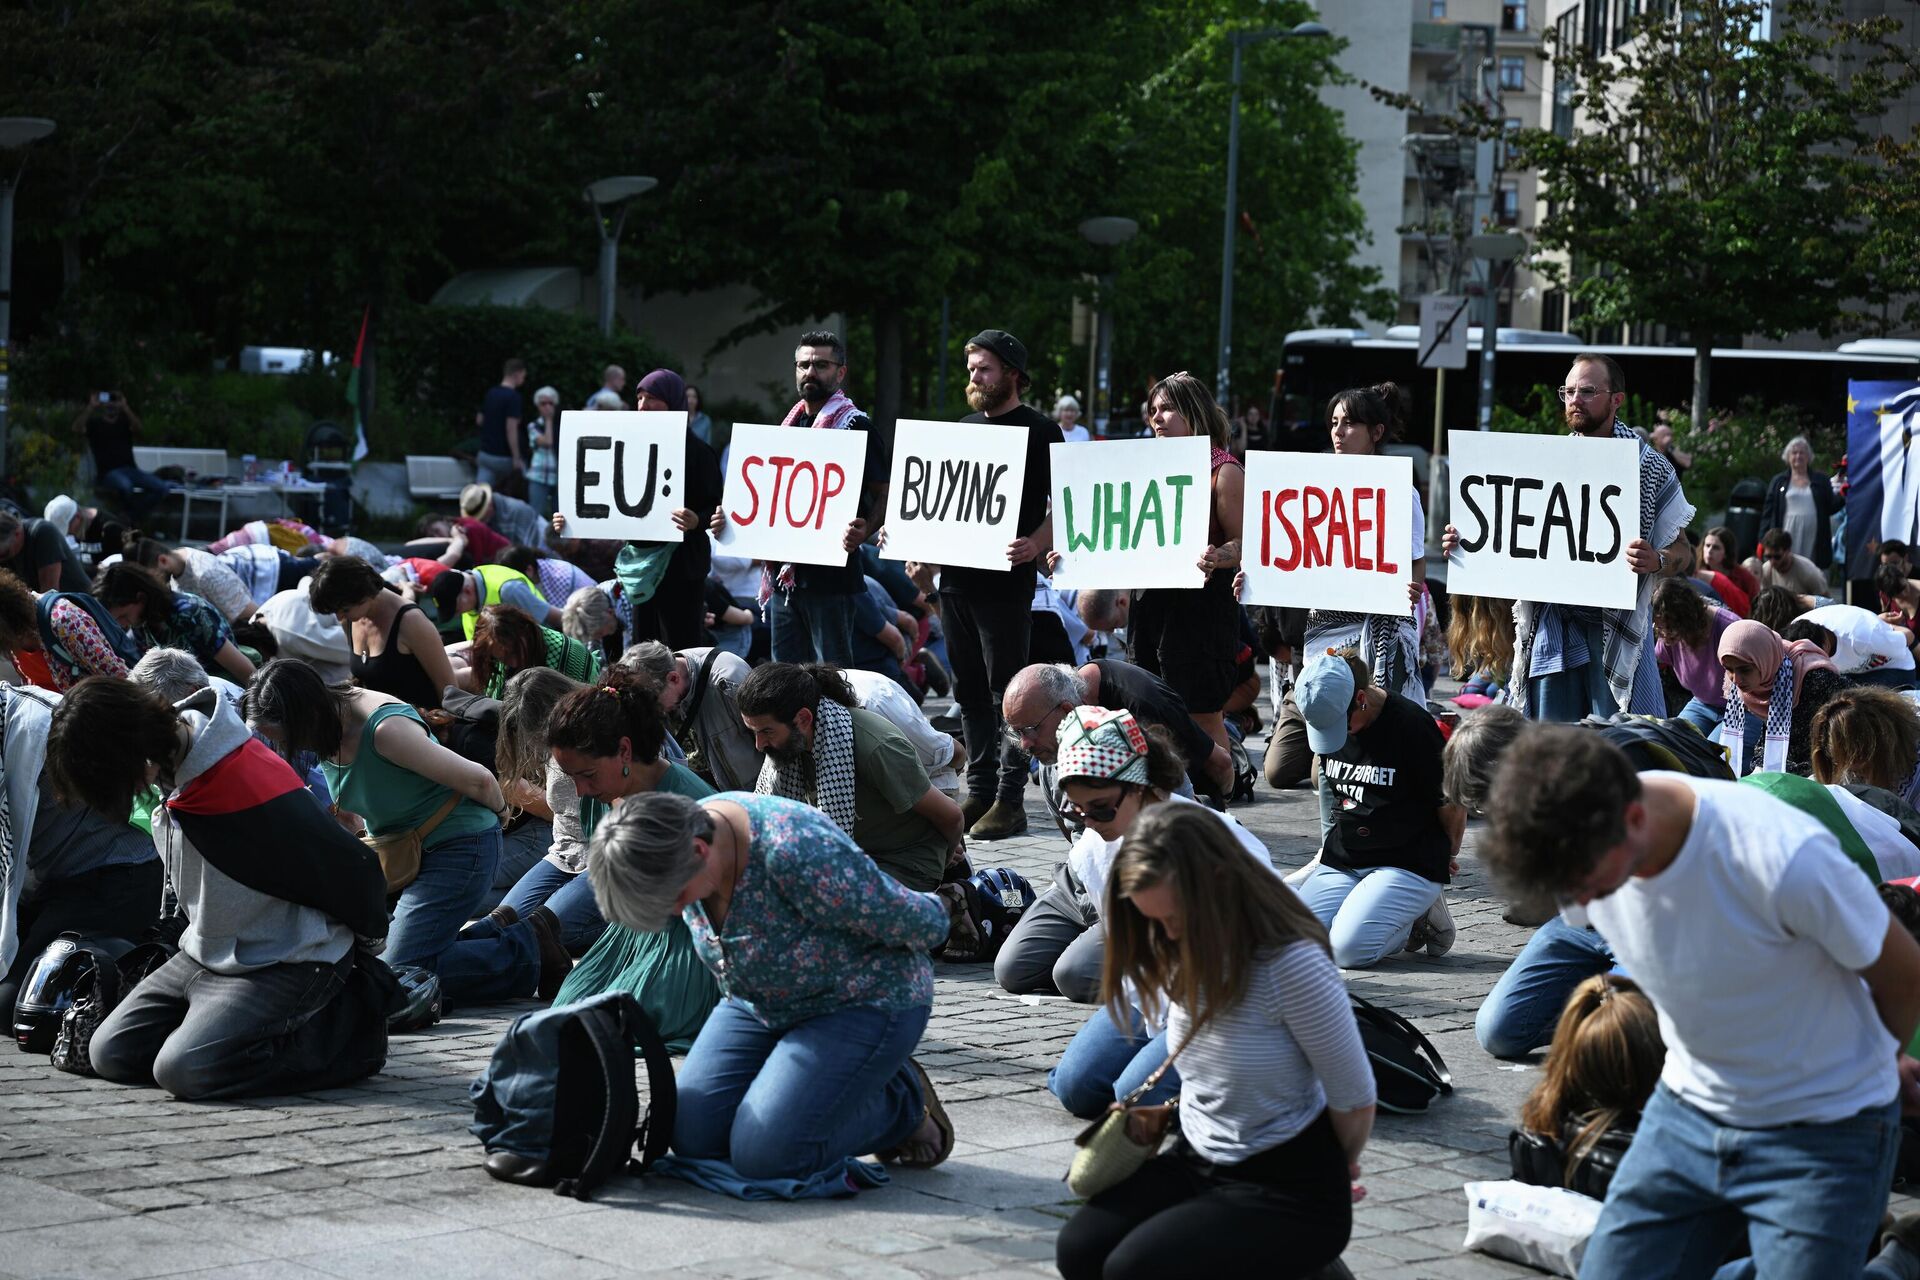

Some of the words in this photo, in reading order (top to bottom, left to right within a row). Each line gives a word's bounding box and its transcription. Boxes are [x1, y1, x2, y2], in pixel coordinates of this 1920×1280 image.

[576, 436, 673, 519] EU:
[731, 456, 845, 529] STOP
[900, 456, 1008, 526] BUYING
[1063, 475, 1193, 553] WHAT
[1261, 486, 1398, 574] ISRAEL
[1459, 474, 1622, 565] STEALS
[1122, 717, 1149, 754] FREE
[1325, 757, 1353, 780] ON'T
[1349, 765, 1396, 786] FORGET
